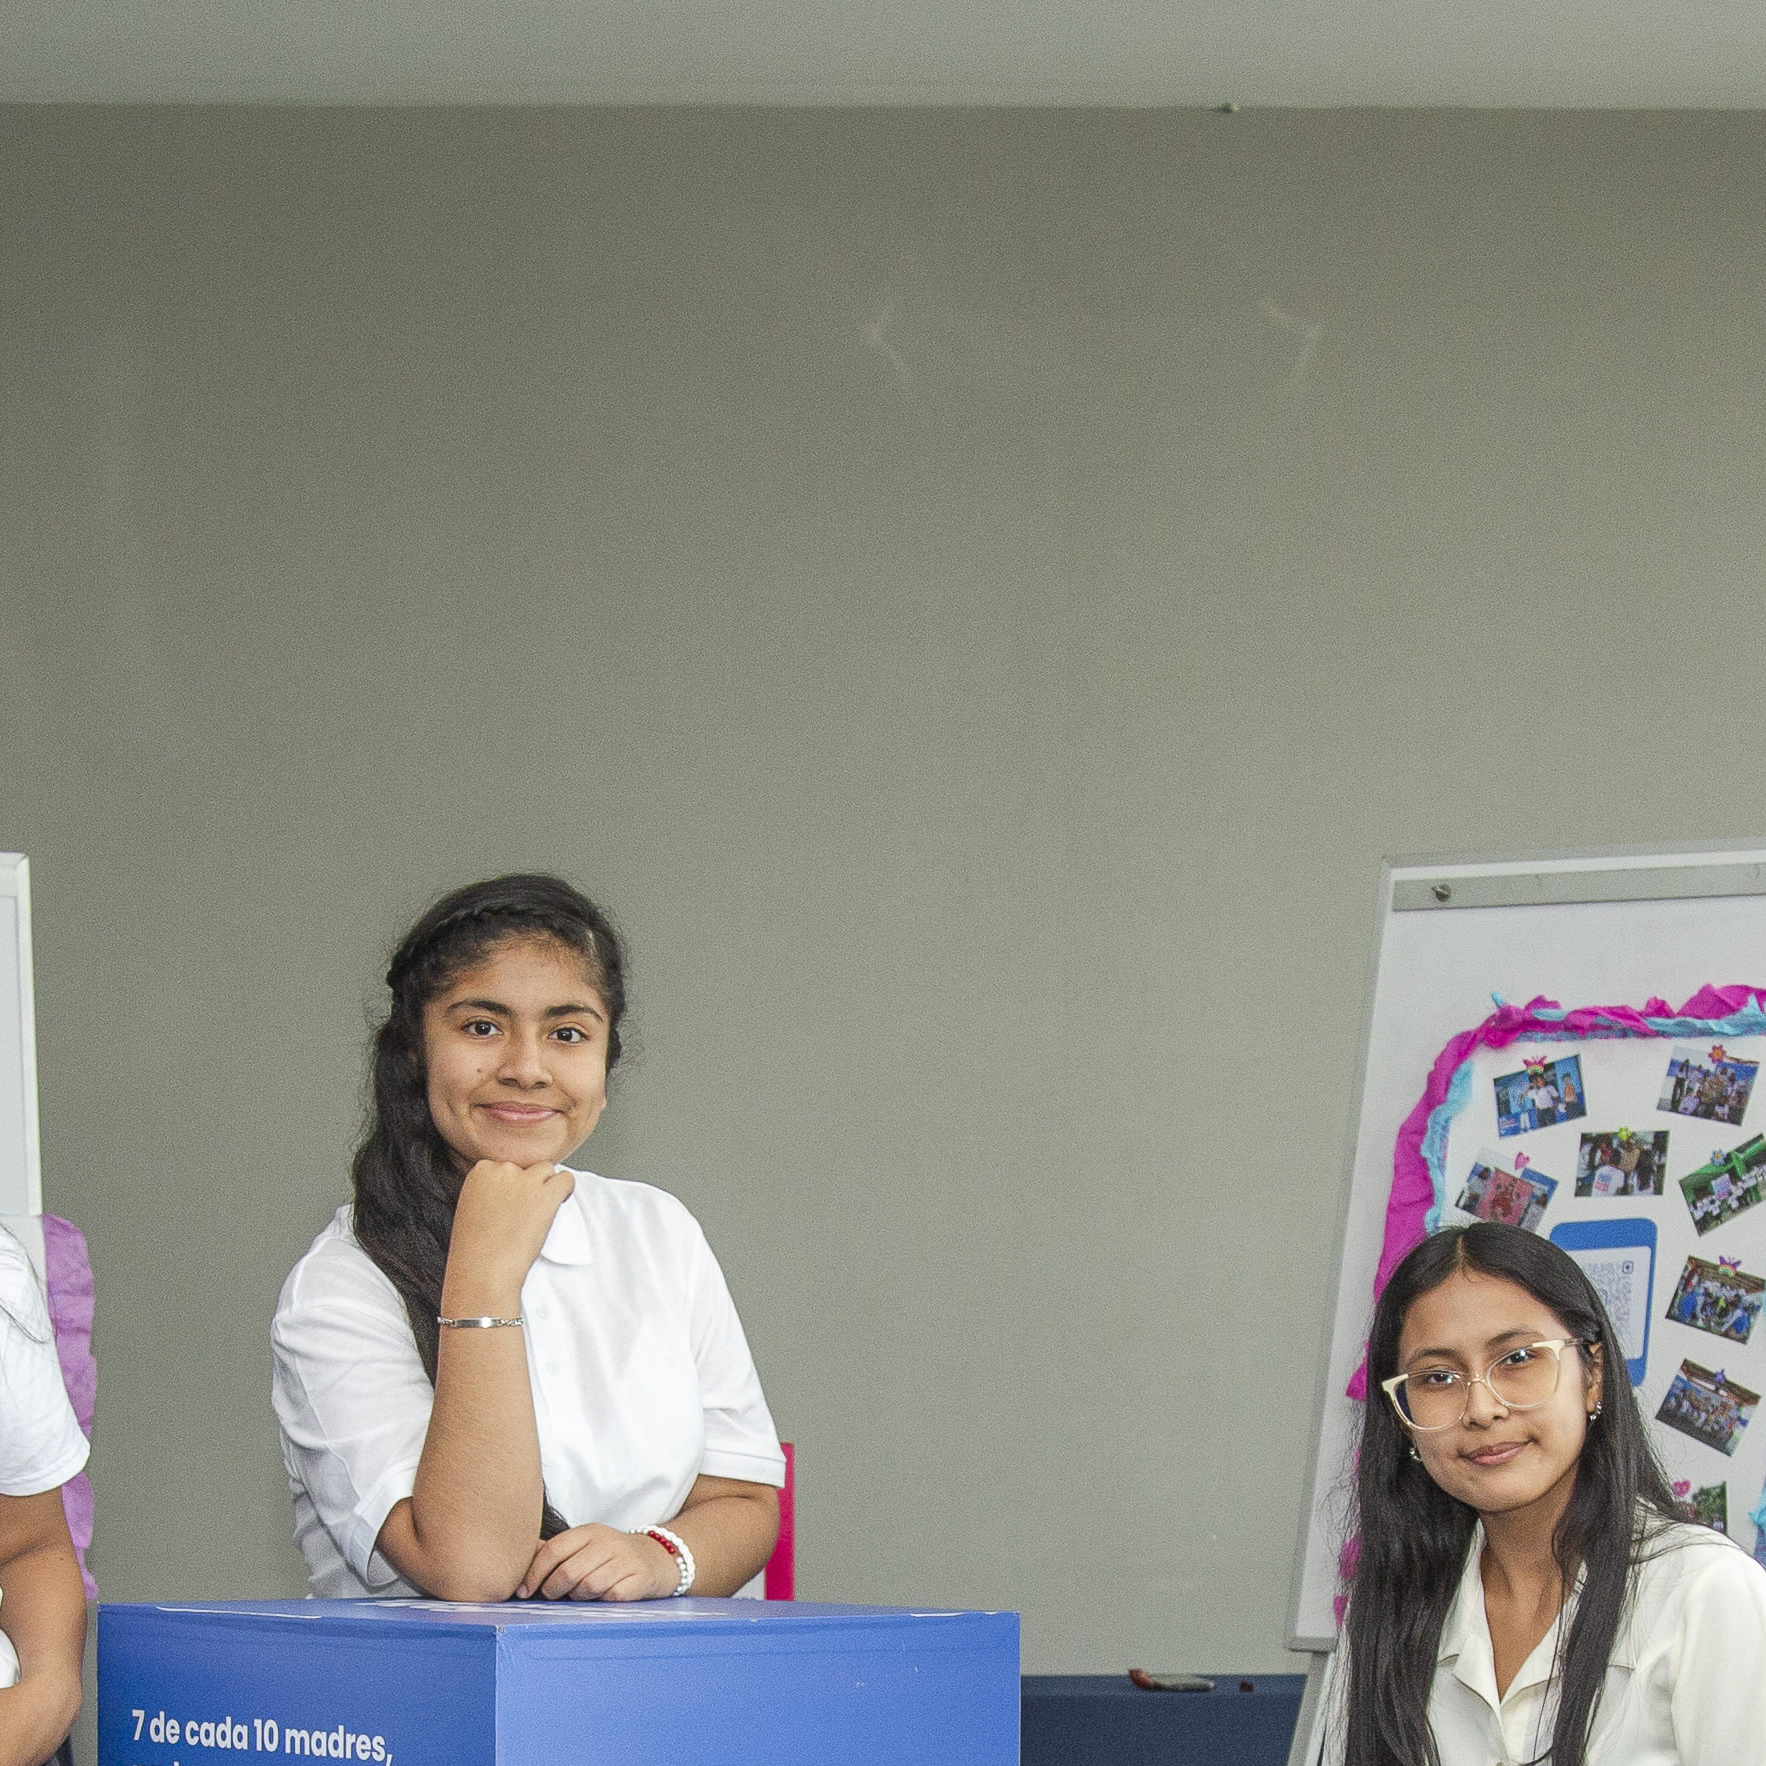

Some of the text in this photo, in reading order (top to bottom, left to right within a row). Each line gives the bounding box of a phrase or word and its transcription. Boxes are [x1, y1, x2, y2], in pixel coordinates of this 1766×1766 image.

[132, 1709, 145, 1741] 7
[149, 1711, 180, 1746] de
[185, 1716, 248, 1750] cada
[253, 1718, 279, 1752] 10
